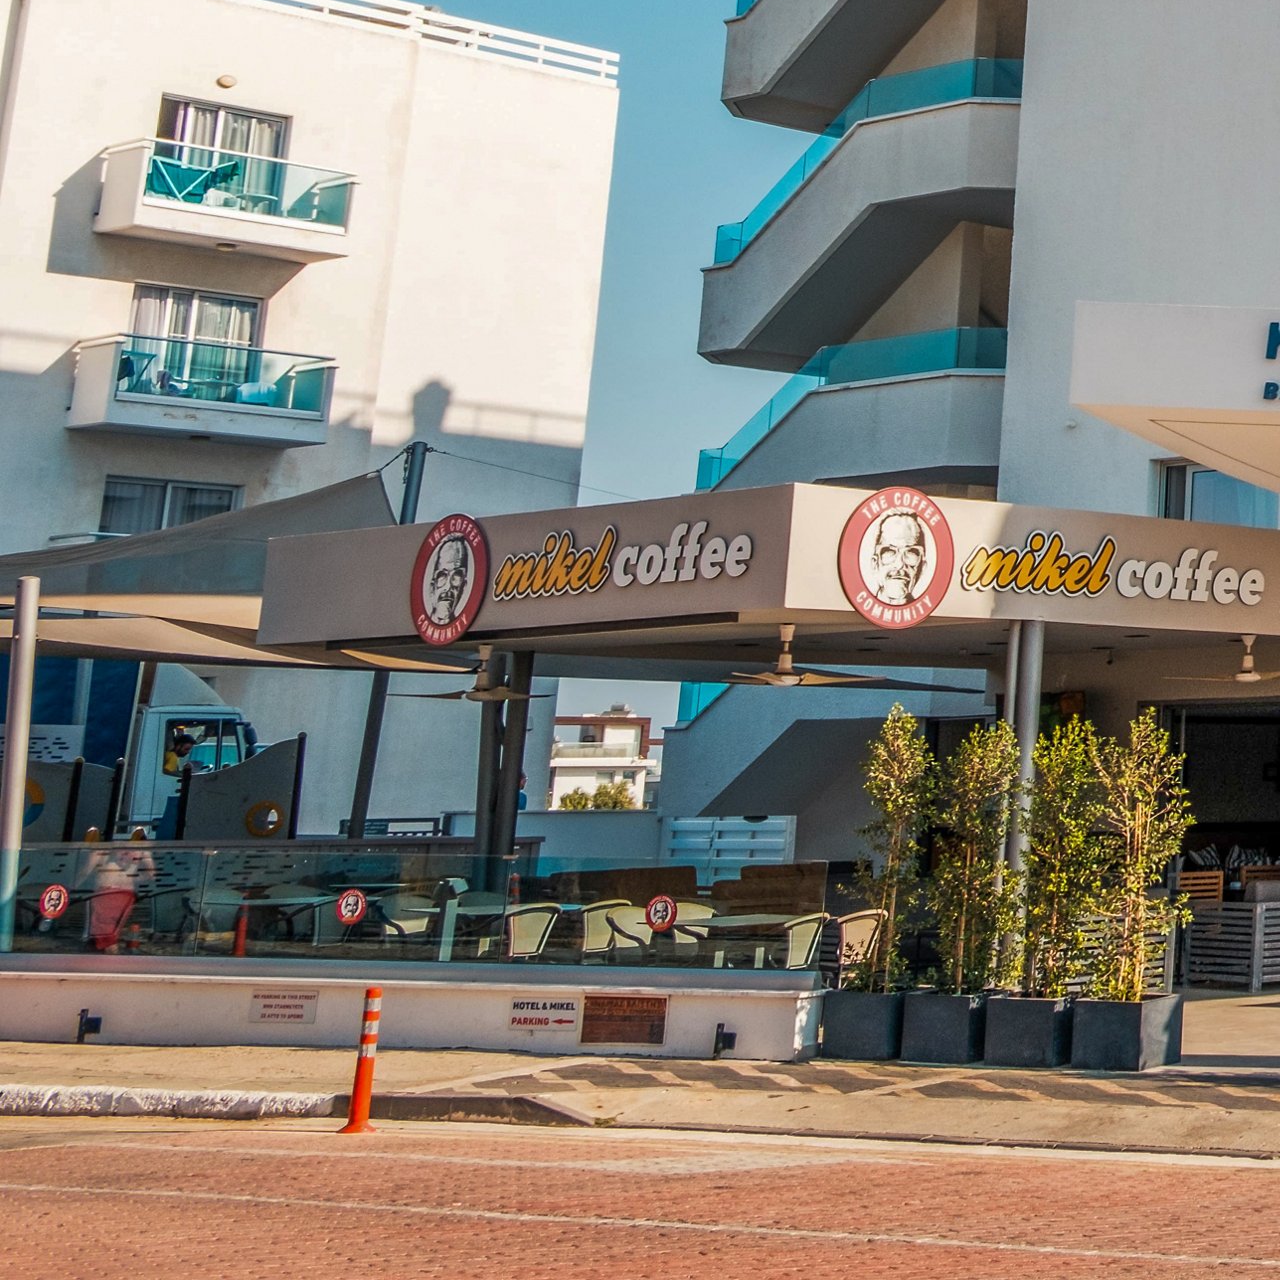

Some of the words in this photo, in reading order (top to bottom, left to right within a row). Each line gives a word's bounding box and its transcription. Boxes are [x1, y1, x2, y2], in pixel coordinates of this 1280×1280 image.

[861, 496, 888, 521] THE
[893, 492, 940, 527] COFFEE
[429, 523, 447, 548] THE
[450, 518, 481, 548] COFFEE
[493, 525, 617, 602] mikel
[613, 521, 752, 587] coffee
[960, 528, 1118, 599] mikel
[1116, 548, 1266, 607] coffee
[856, 589, 933, 626] COMMUNITY
[417, 612, 470, 643] COMMUNITY
[511, 1016, 550, 1026] PARKING
[513, 1001, 540, 1010] HOTEL
[542, 1002, 548, 1011] &
[550, 1002, 576, 1011] MIKEL
